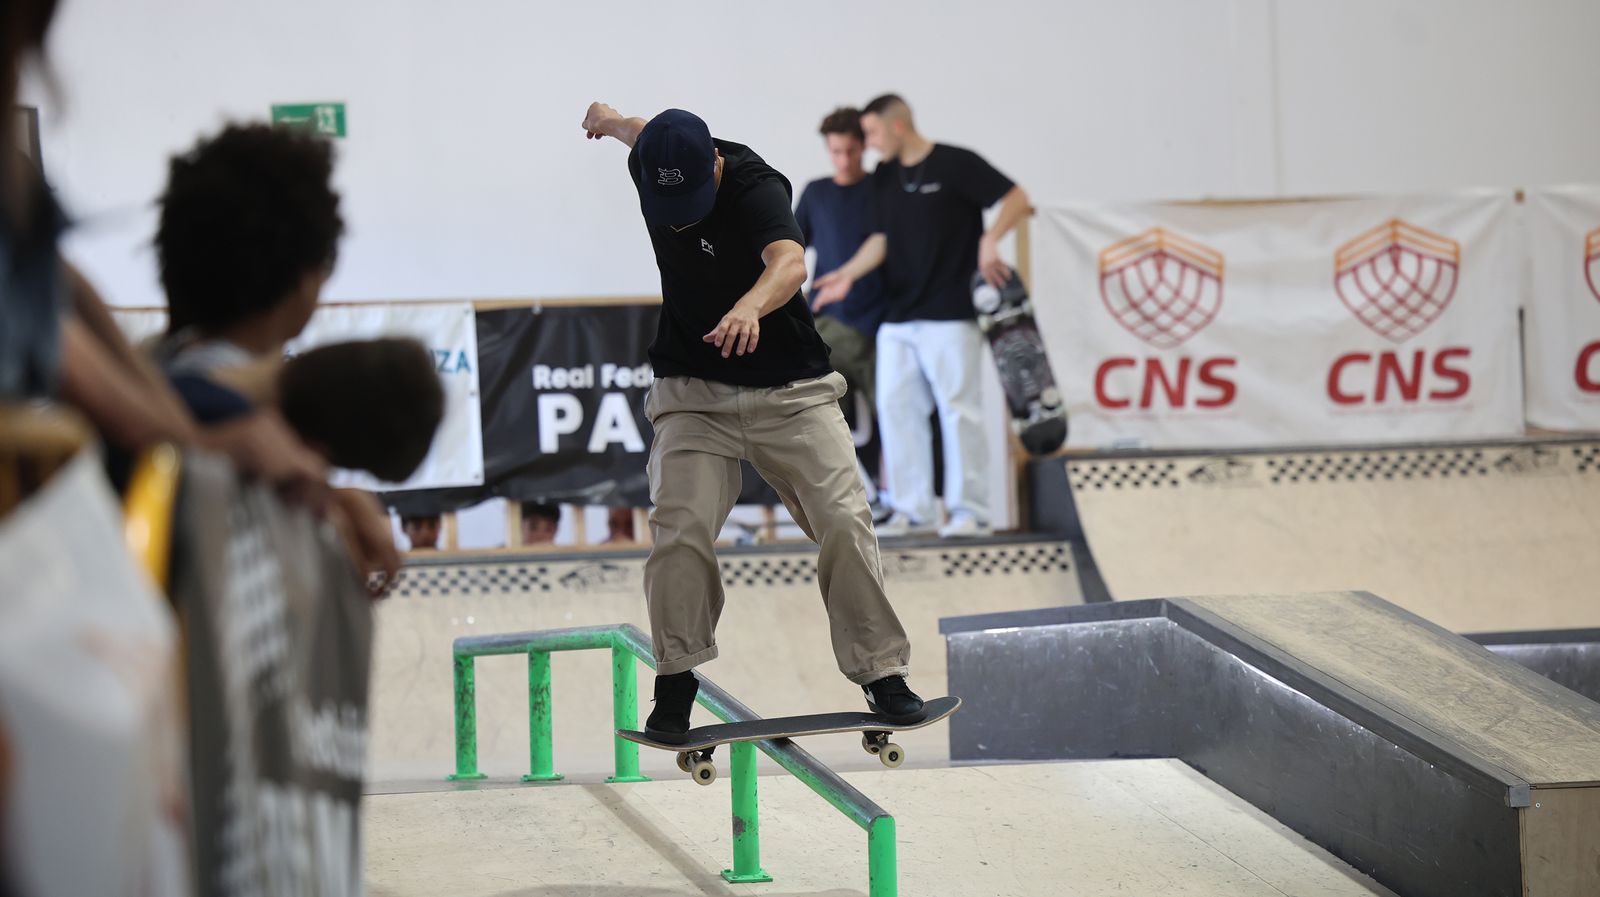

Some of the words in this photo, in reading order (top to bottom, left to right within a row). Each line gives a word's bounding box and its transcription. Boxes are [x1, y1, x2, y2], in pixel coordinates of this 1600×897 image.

[532, 364, 594, 389] Real
[601, 362, 654, 388] Fed
[1094, 356, 1238, 408] CNS
[1326, 347, 1472, 405] CNS
